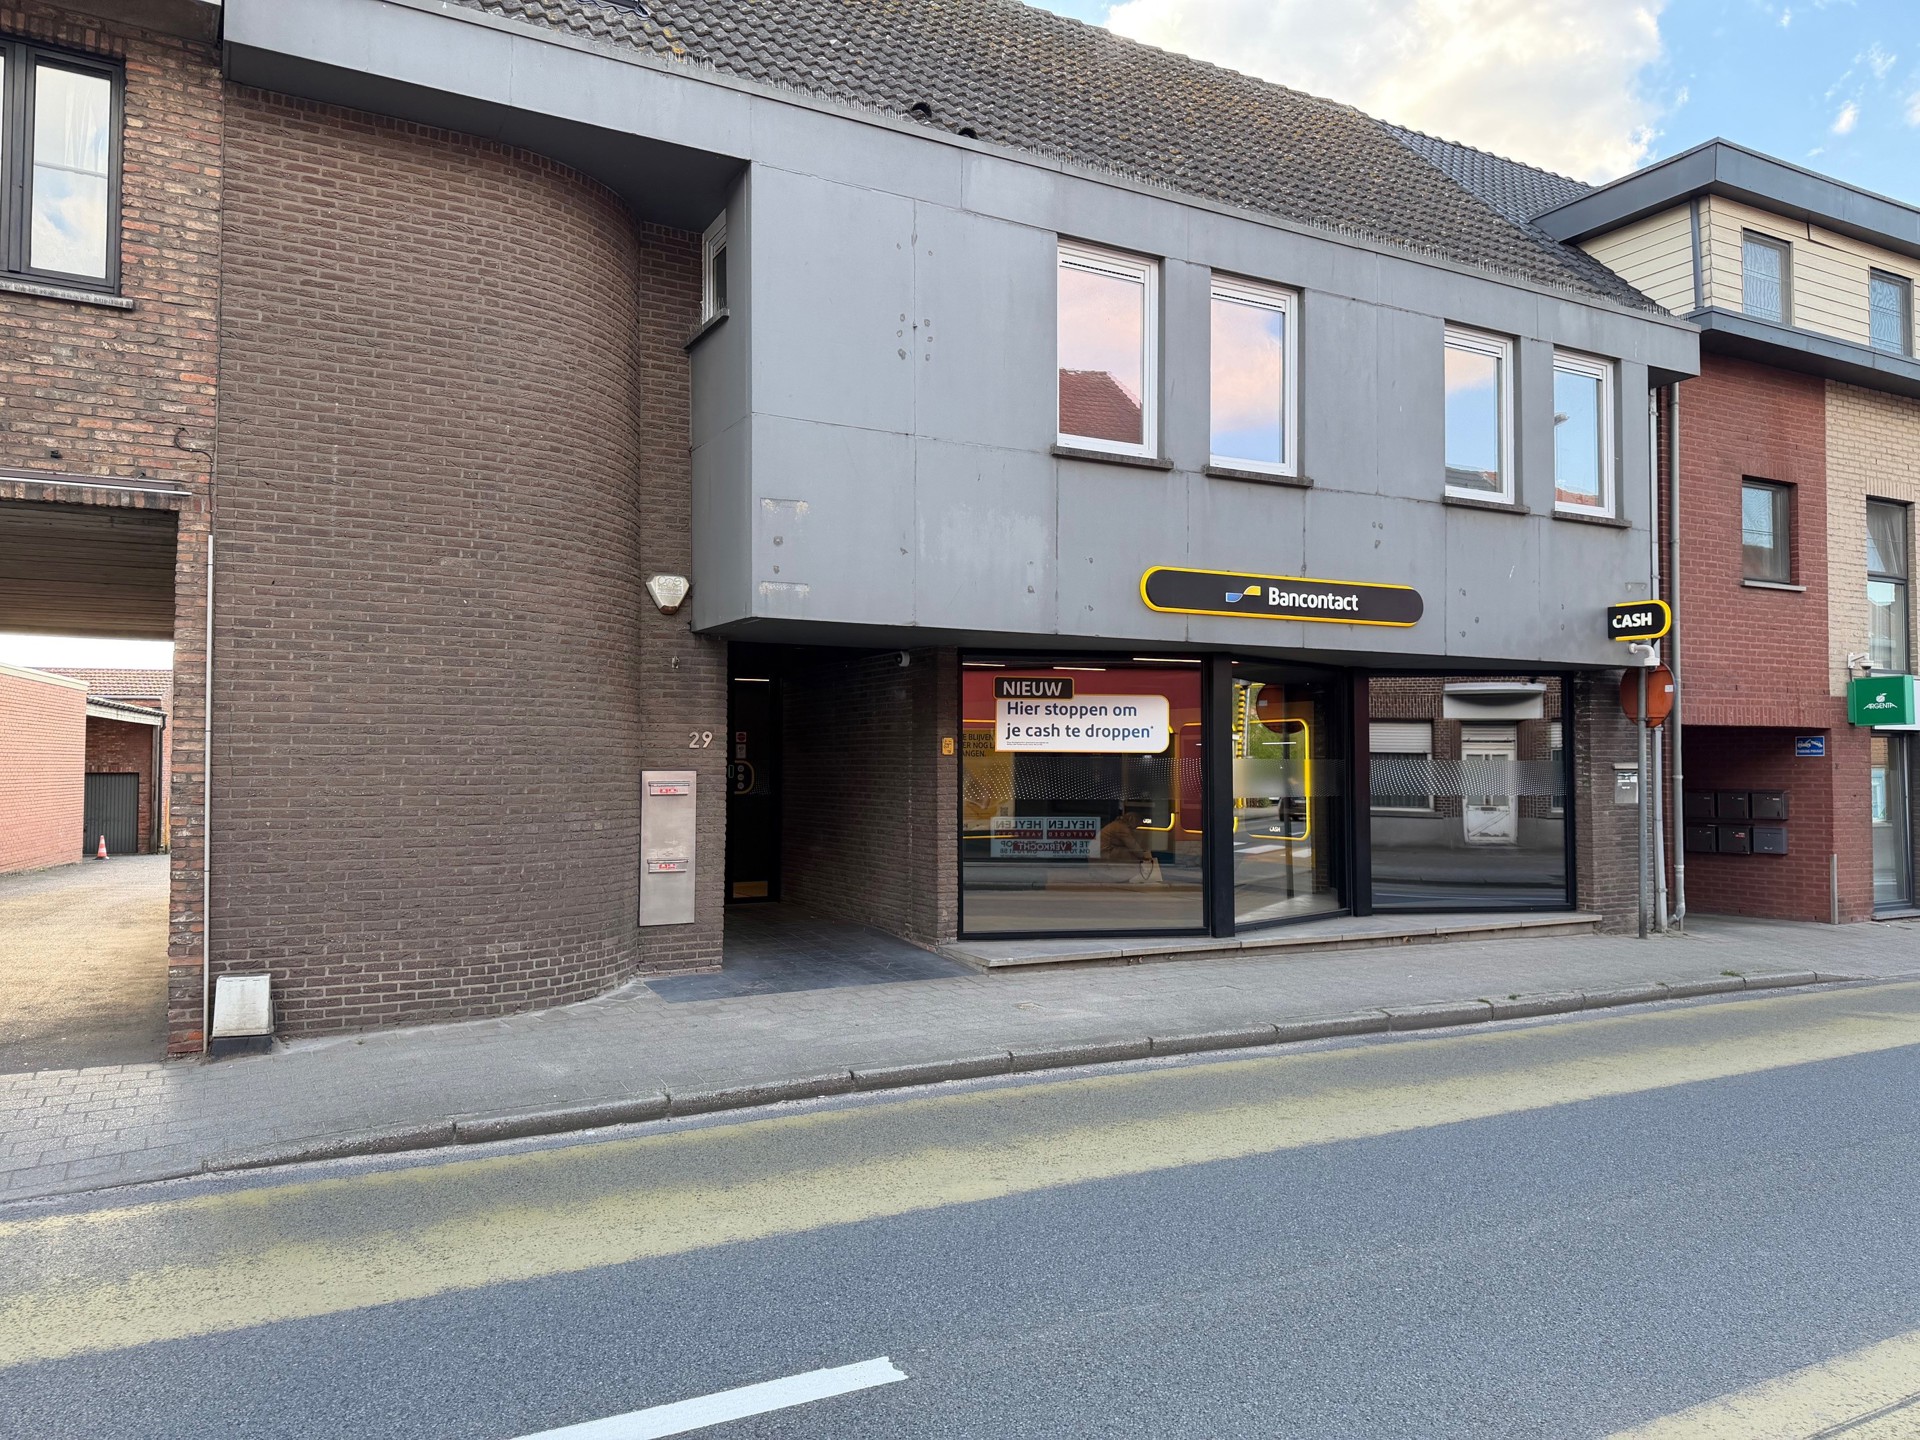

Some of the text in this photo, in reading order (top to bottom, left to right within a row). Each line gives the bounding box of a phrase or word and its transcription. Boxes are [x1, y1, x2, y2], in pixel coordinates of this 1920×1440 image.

[1268, 587, 1359, 612] Bancontact
[1612, 611, 1653, 629] CASH
[1003, 681, 1063, 696] NIEUW
[1007, 701, 1137, 719] Hier stoppen om
[1863, 702, 1898, 710] ARGENTA
[688, 731, 713, 749] 29
[1005, 723, 1021, 740] je
[1025, 723, 1060, 738] cash
[1066, 725, 1081, 738] te
